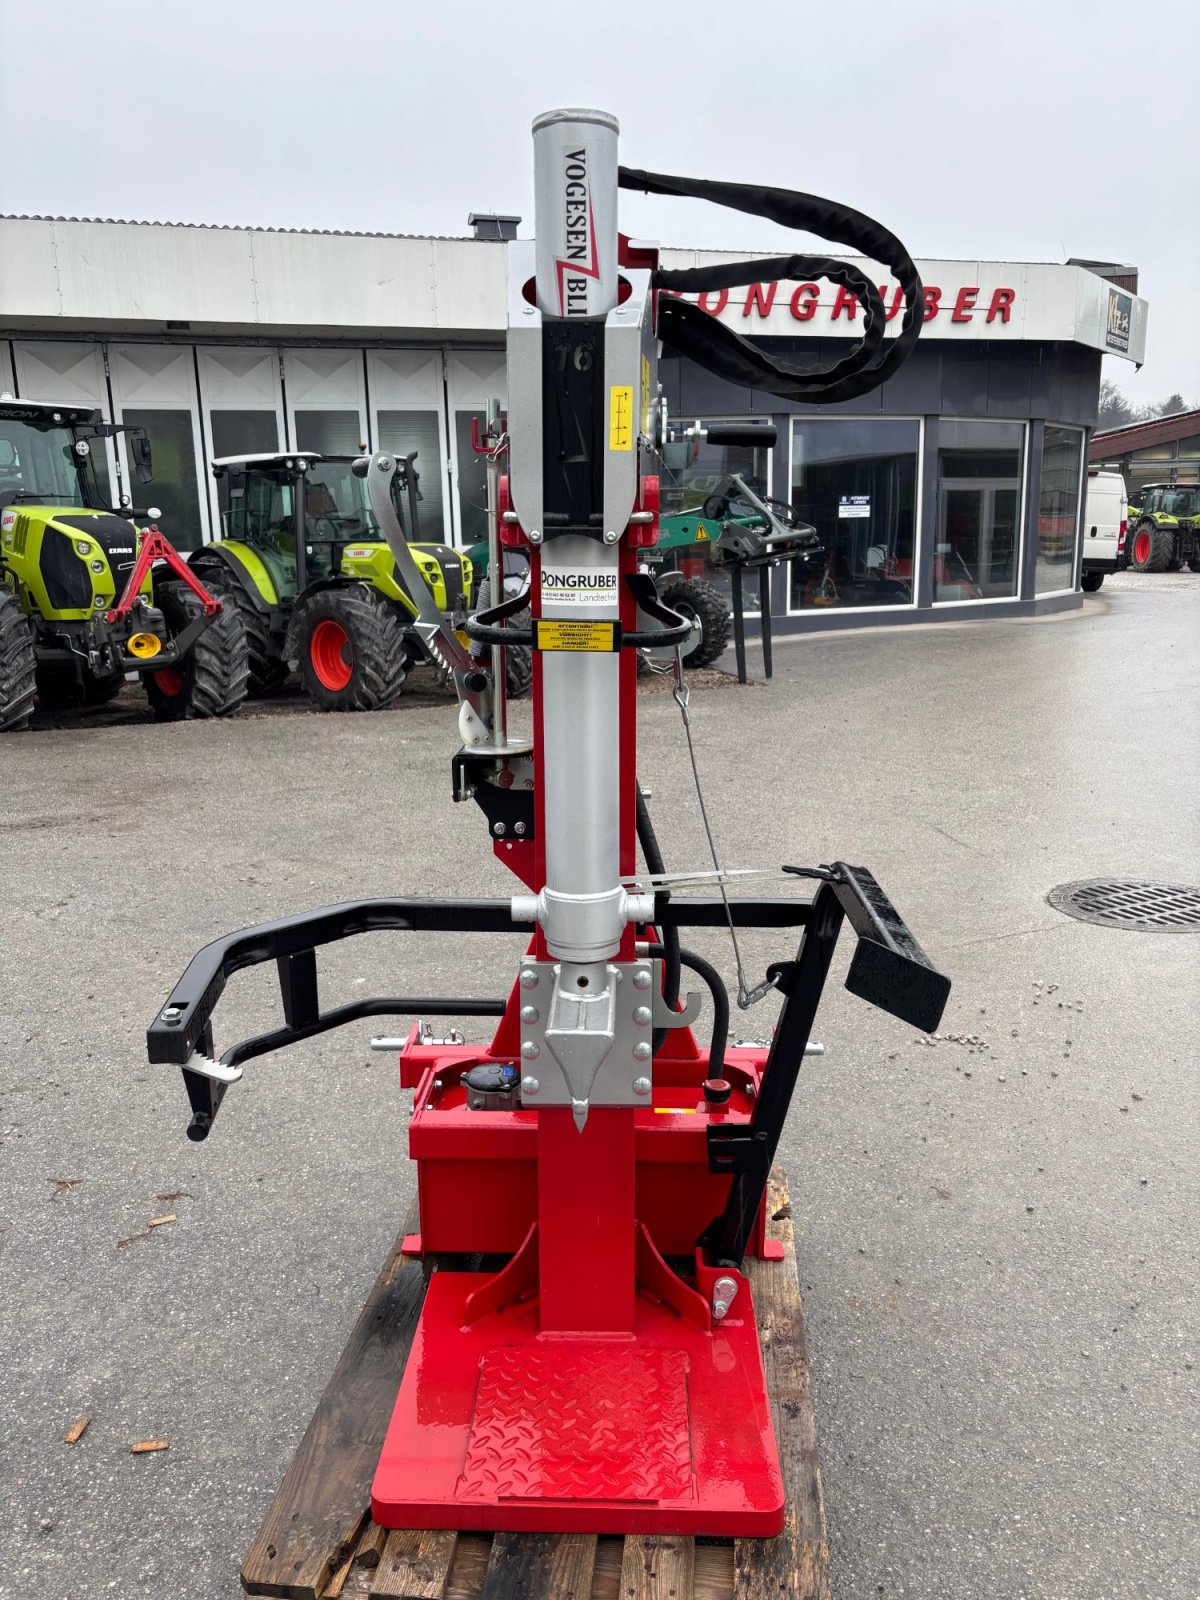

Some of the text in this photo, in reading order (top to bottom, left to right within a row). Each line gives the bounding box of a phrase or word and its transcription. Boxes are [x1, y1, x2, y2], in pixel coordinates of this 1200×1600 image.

[565, 148, 588, 315] VOGESEN BLI
[661, 281, 1016, 323] ONGRUBER
[109, 547, 133, 555] CLAAS
[541, 571, 616, 588] PONGRUBER
